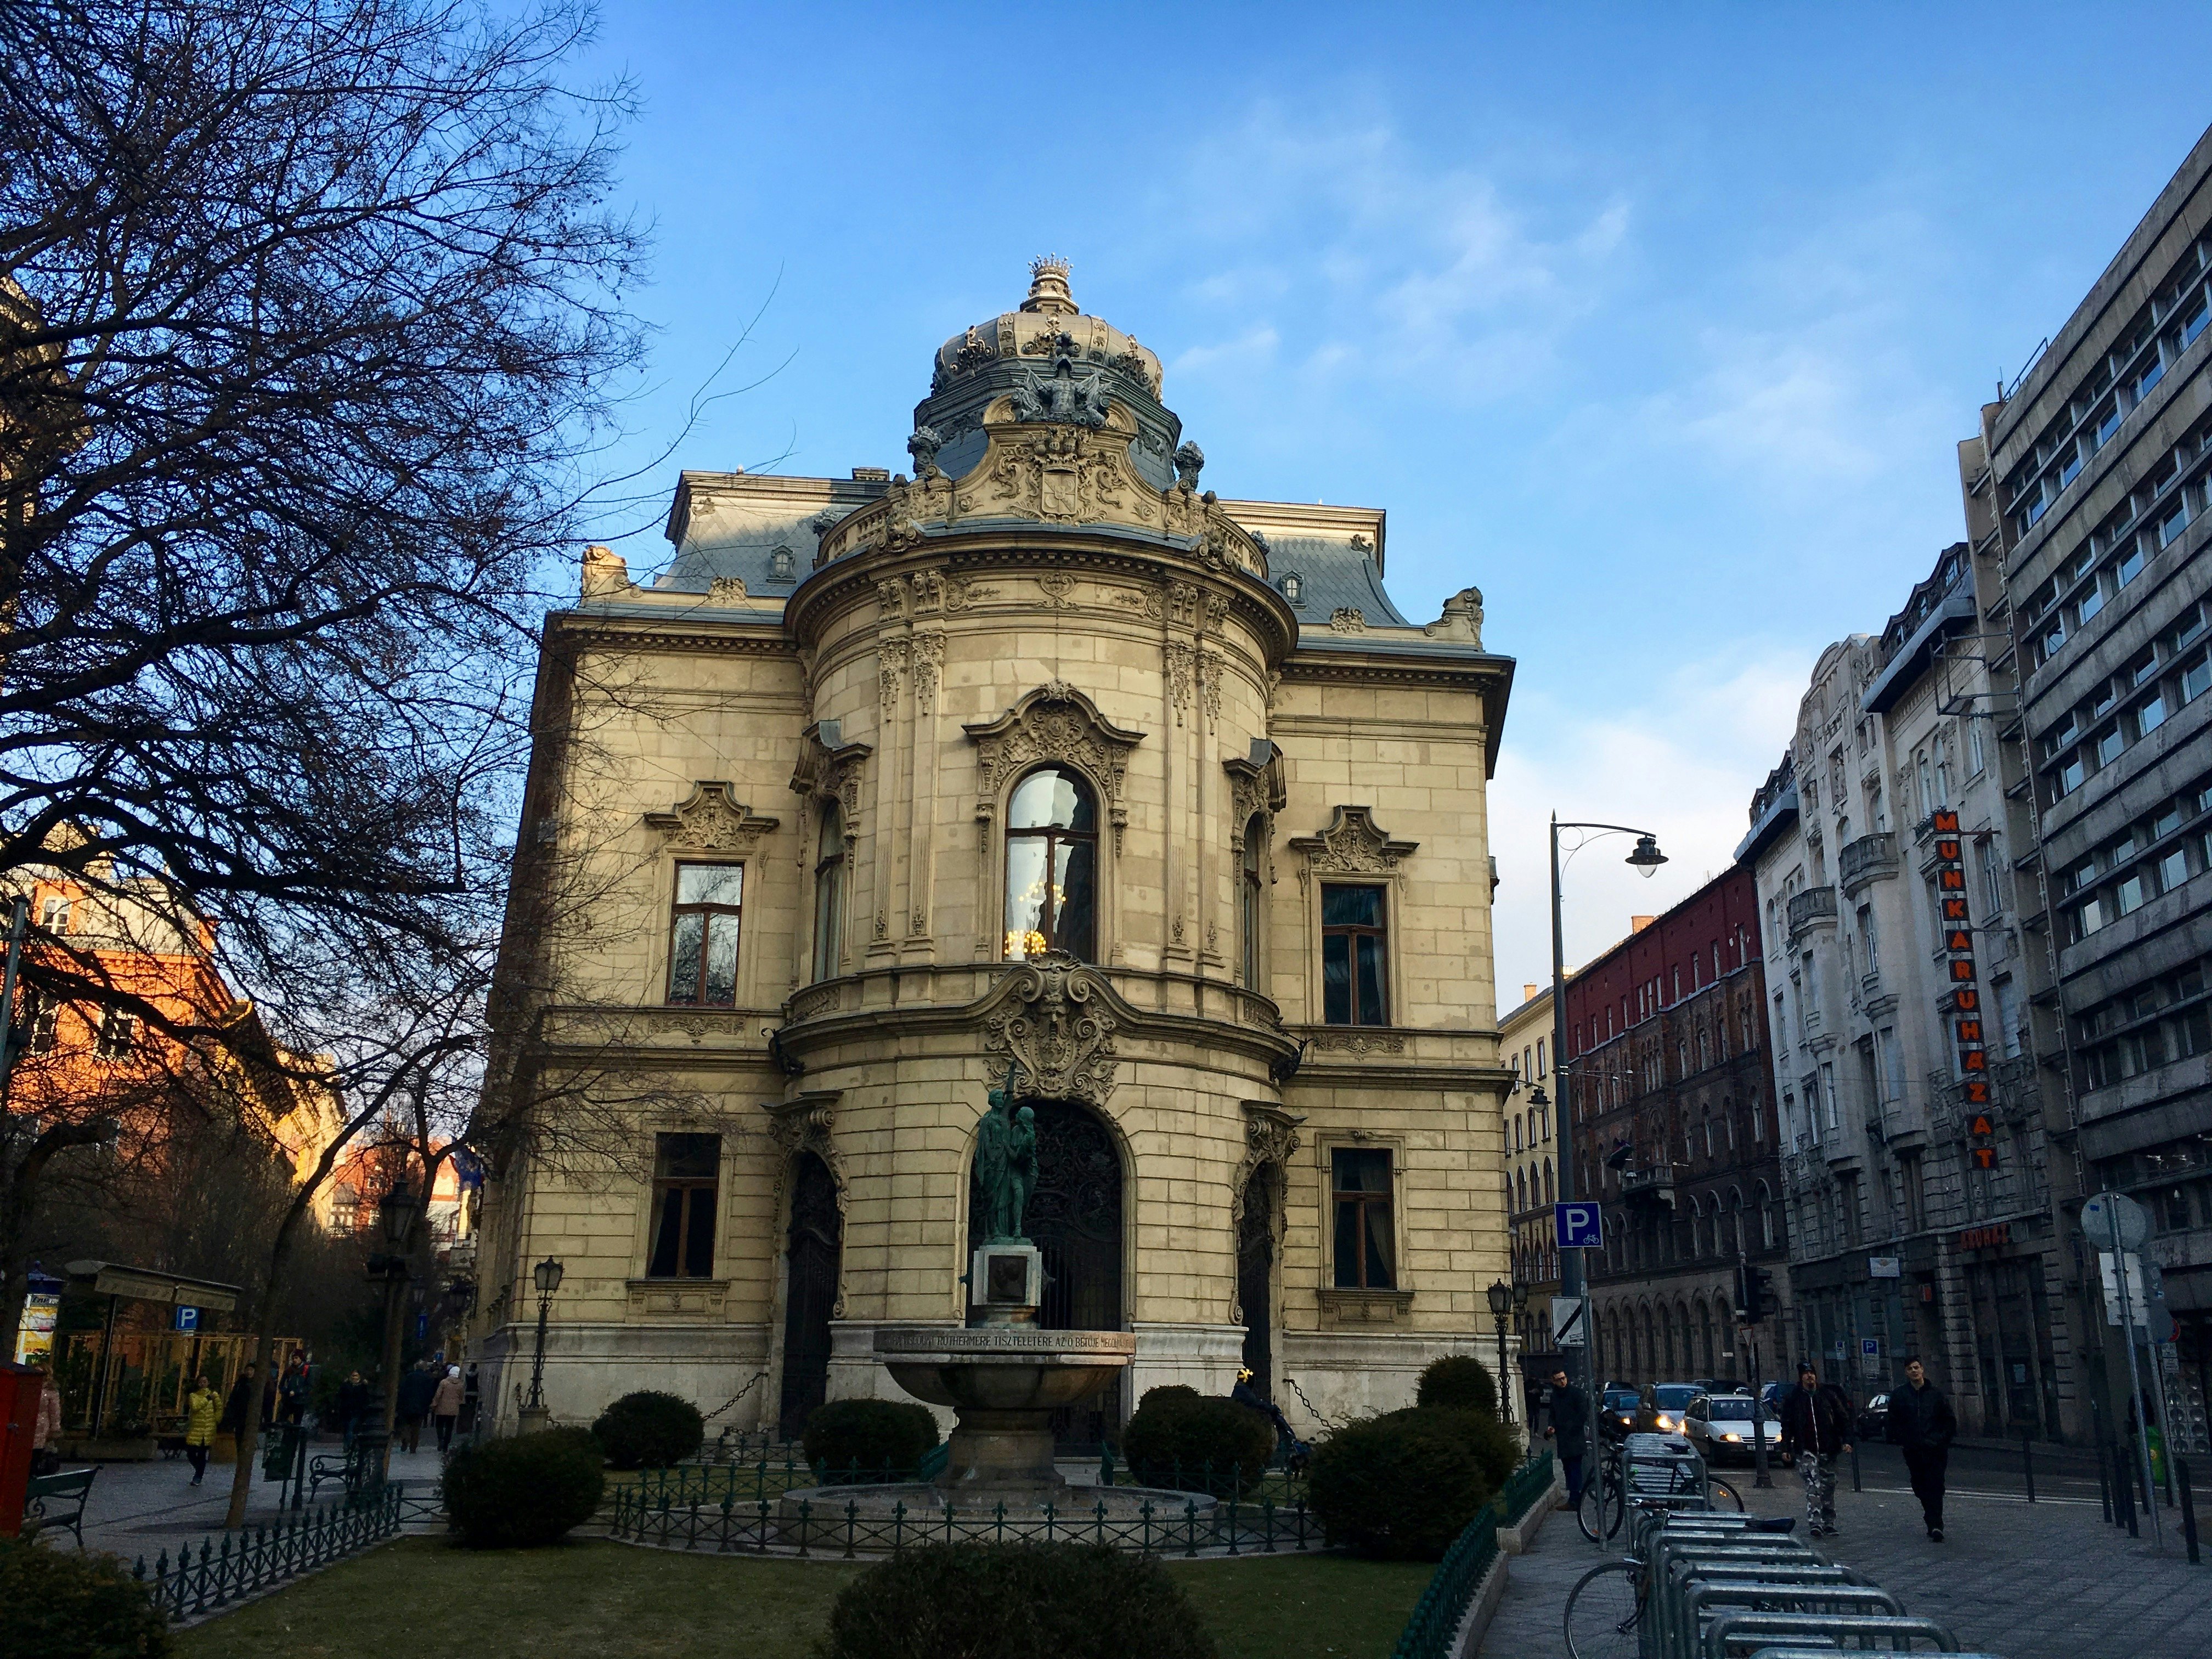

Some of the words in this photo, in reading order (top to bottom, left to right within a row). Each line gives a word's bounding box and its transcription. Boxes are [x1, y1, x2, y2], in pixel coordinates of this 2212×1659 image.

[1566, 1209, 1589, 1241] P
[180, 1308, 196, 1327] P
[1866, 1341, 1874, 1352] P
